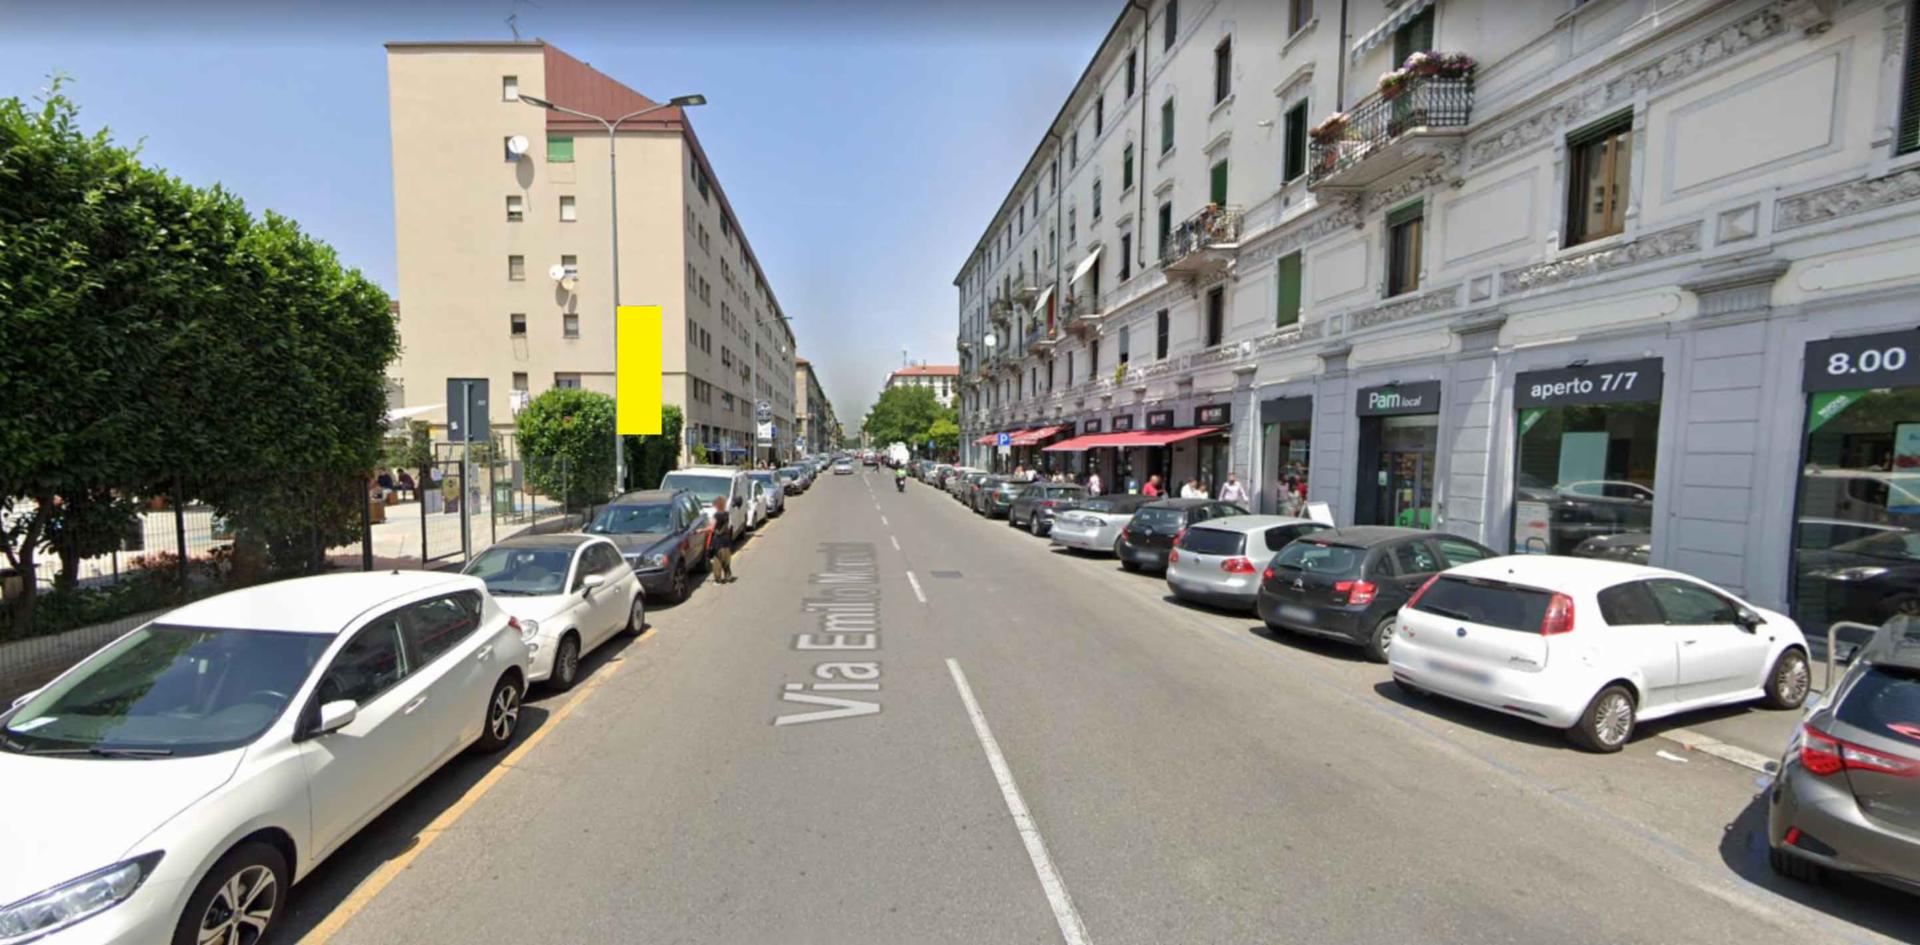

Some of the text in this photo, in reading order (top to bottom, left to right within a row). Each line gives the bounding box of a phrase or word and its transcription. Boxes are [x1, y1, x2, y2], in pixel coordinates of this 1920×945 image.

[1827, 346, 1906, 375] 8.00
[1530, 371, 1638, 400] aperto 7/7
[1369, 391, 1422, 409] Pam local
[1000, 435, 1008, 445] P
